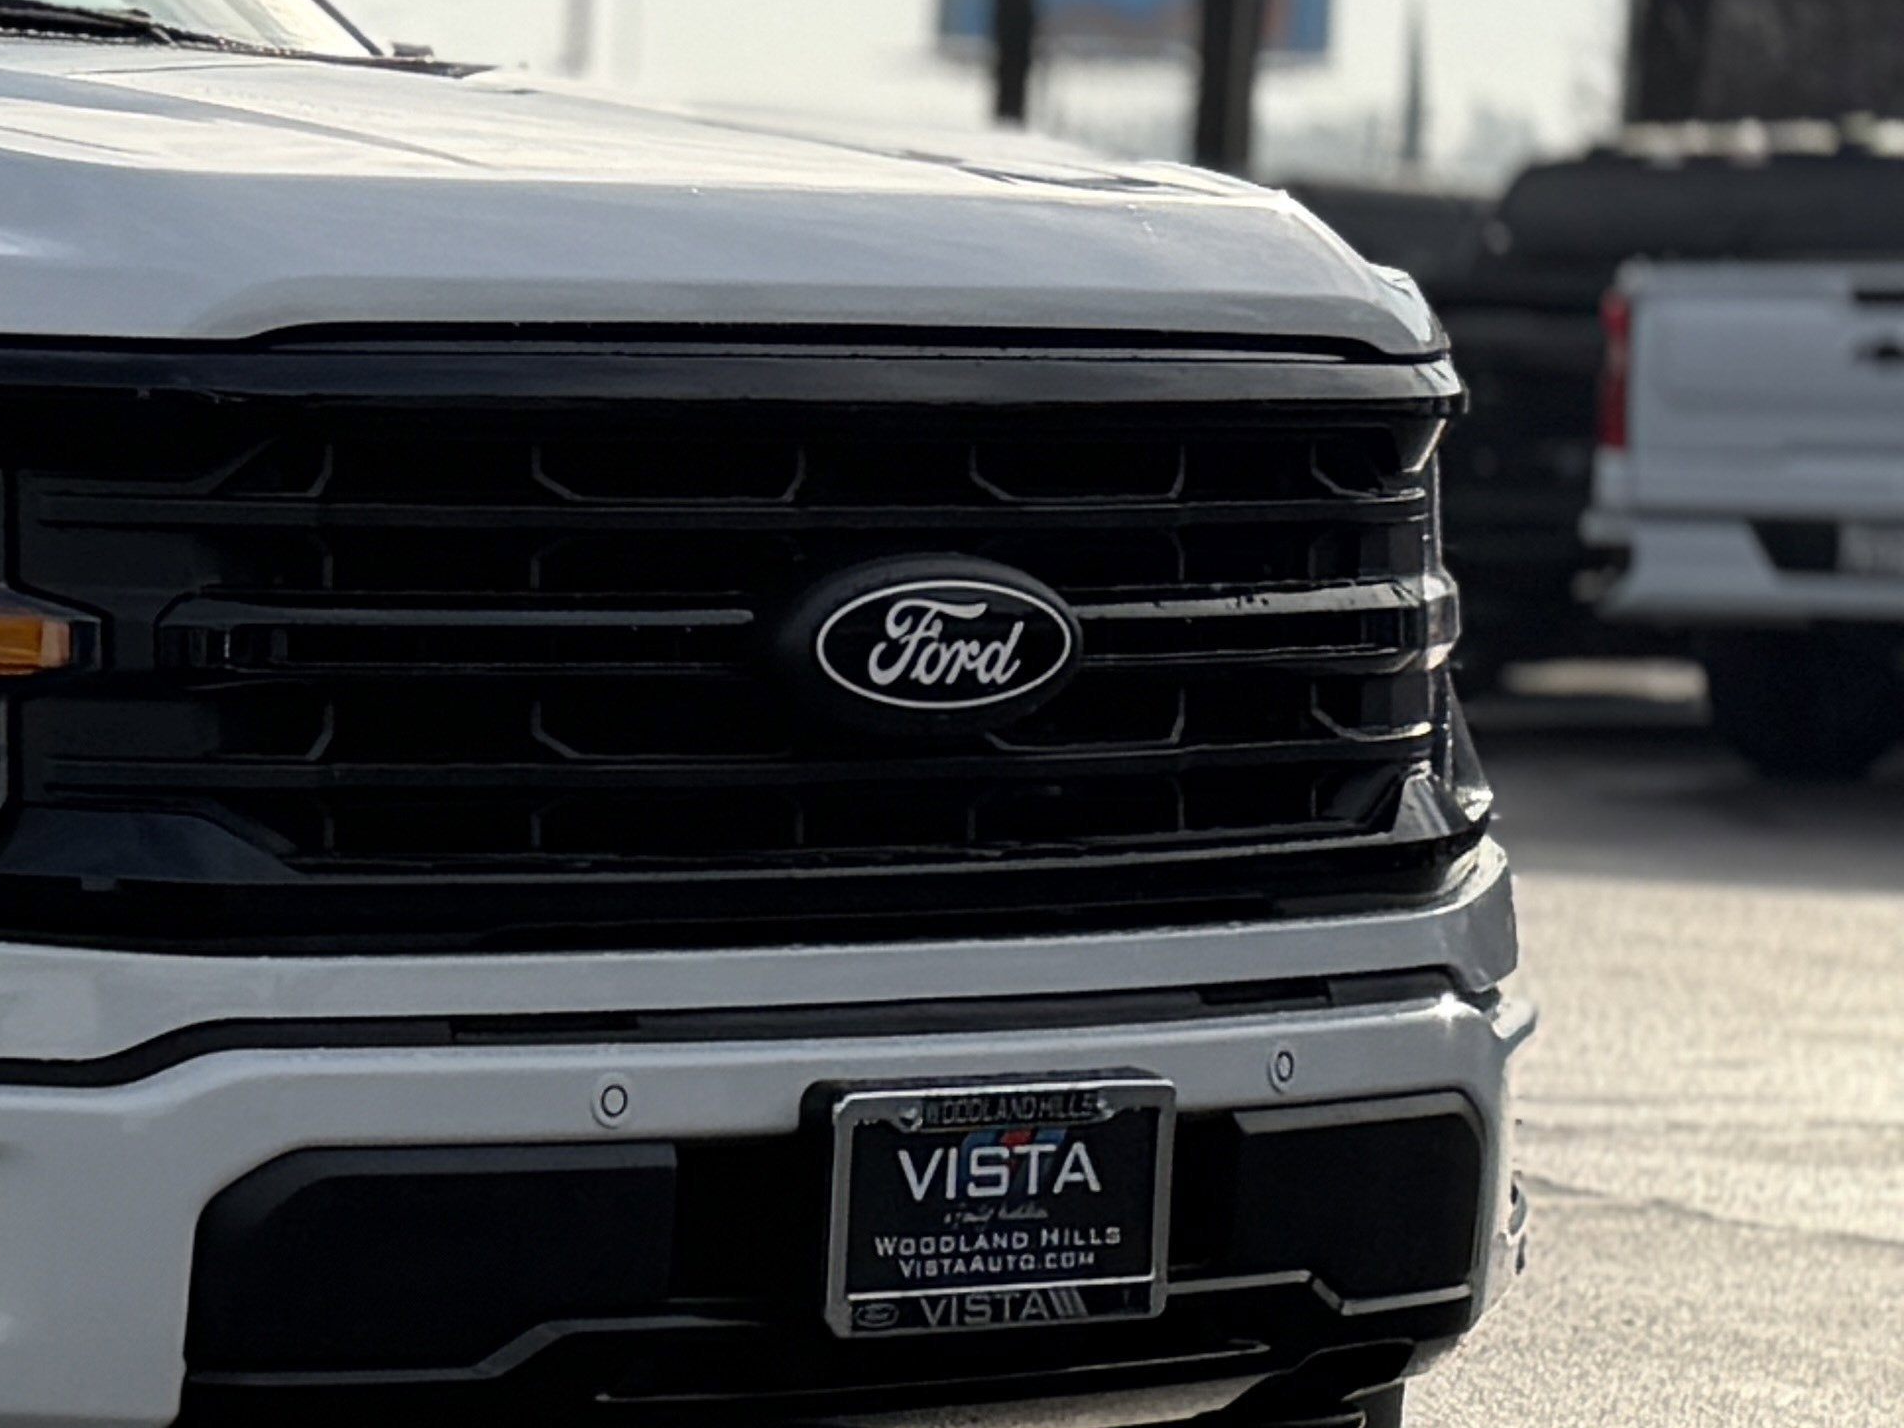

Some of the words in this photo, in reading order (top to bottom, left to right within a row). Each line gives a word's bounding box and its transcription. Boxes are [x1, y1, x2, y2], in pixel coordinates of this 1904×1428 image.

[867, 597, 1025, 686] Ford
[897, 1140, 1102, 1202] VISTA
[919, 1289, 1052, 1328] VISTA
